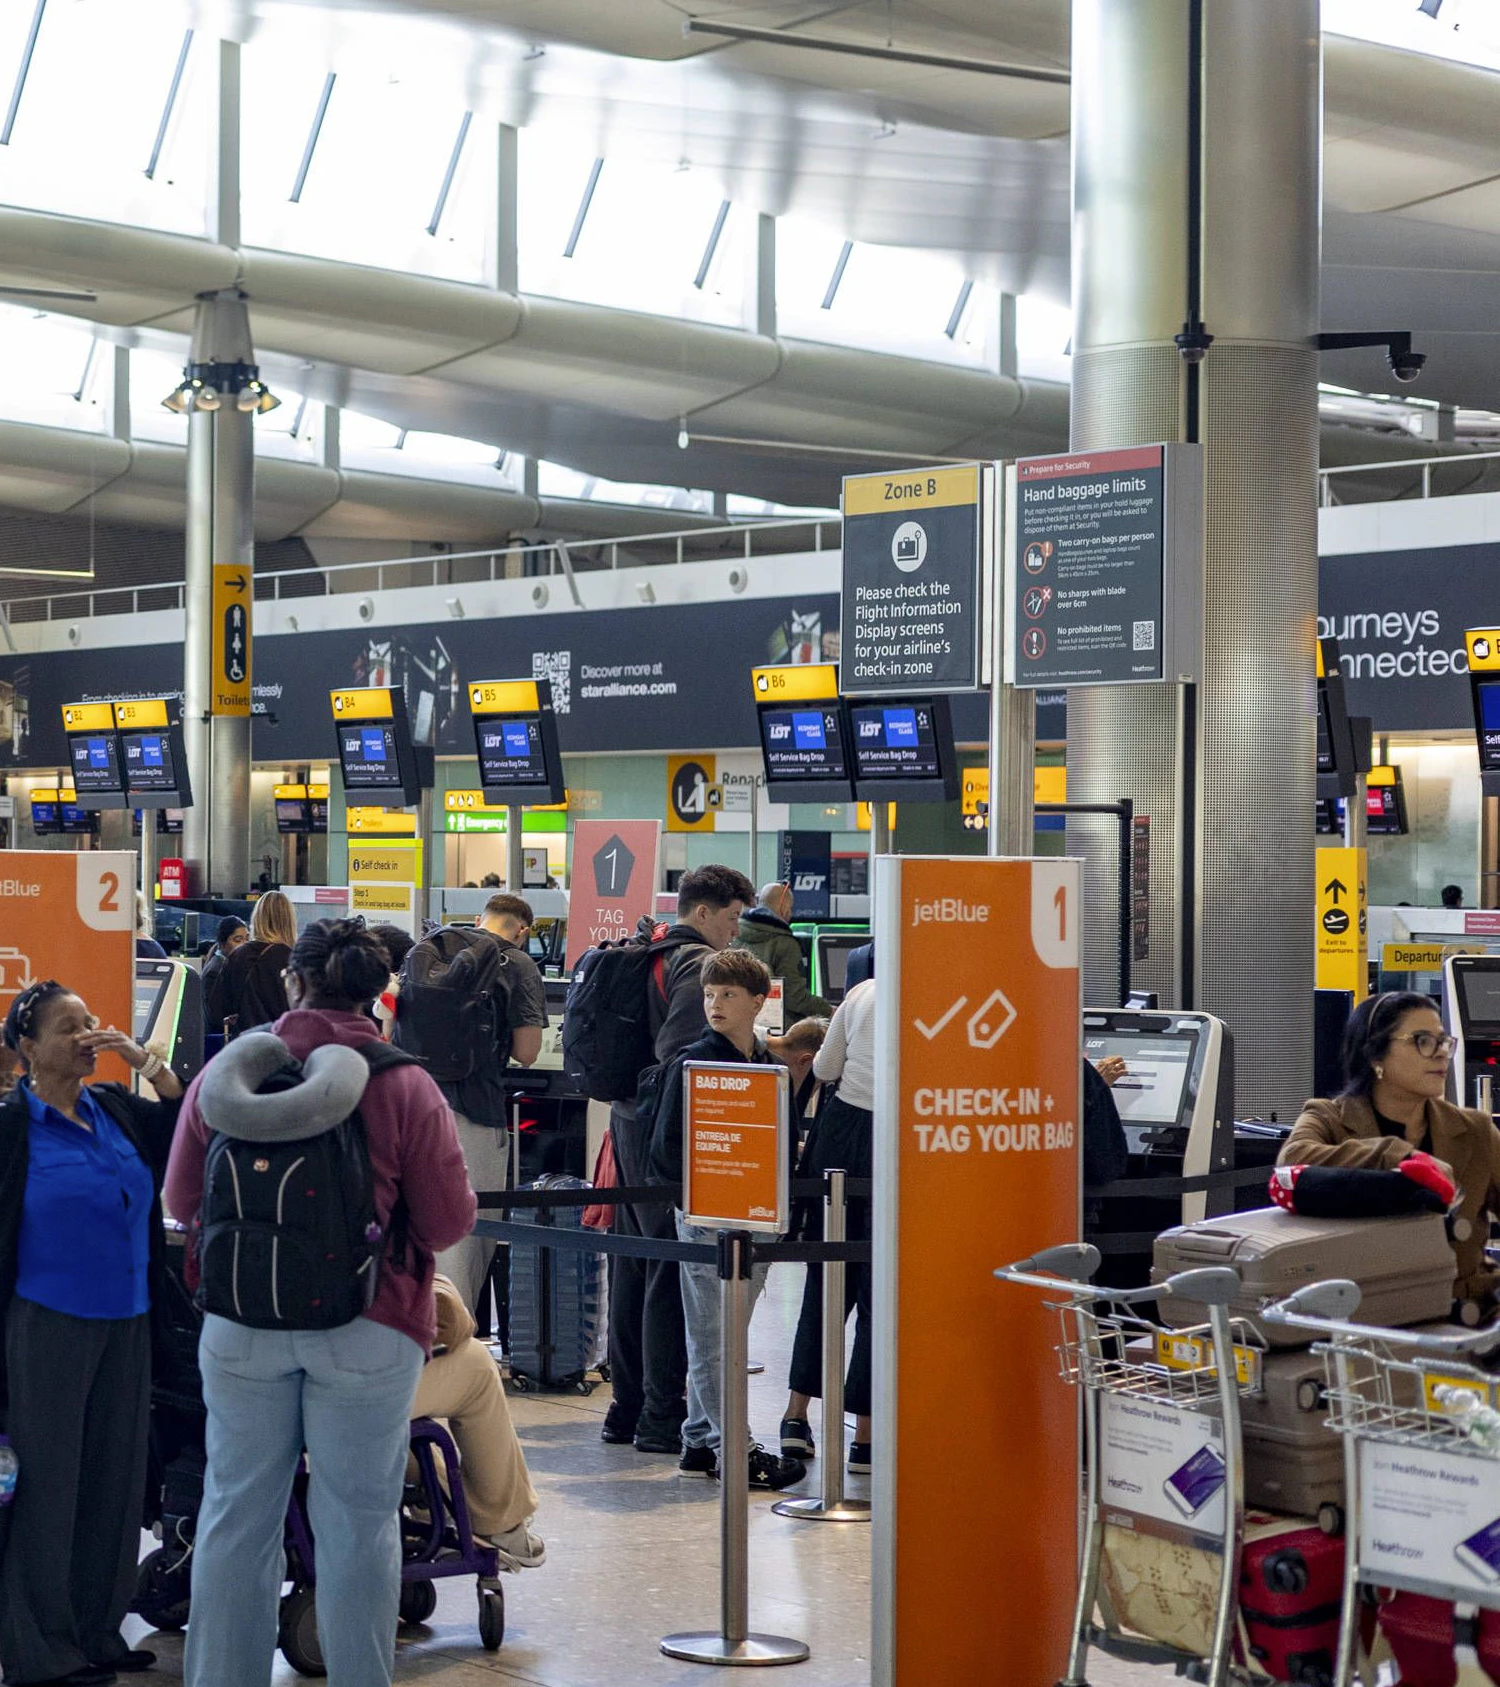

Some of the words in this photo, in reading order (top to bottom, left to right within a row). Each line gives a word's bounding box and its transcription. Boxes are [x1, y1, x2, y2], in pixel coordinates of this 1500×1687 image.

[1029, 464, 1054, 474] Prepare
[1054, 464, 1064, 472] for
[1065, 461, 1091, 471] Security
[884, 483, 922, 500] Zone
[927, 478, 937, 496] B
[1024, 486, 1055, 502] Hand
[1058, 483, 1110, 500] baggage
[1112, 477, 1146, 493] limits
[1058, 538, 1072, 547] Two
[1073, 537, 1100, 547] carry-on
[1101, 535, 1118, 544] bags
[1118, 534, 1131, 543] per
[1131, 532, 1155, 542] person
[856, 587, 892, 601] Please
[894, 582, 928, 598] check
[929, 581, 950, 595] the
[1058, 590, 1068, 599] No
[1068, 589, 1090, 599] sharps
[1091, 587, 1106, 596] with
[1107, 585, 1126, 595] blade
[856, 605, 888, 622] Flight
[891, 600, 961, 617] Information
[1073, 600, 1087, 608] 6cm
[856, 623, 897, 641] Display
[900, 622, 944, 636] screens
[1058, 626, 1067, 635] No
[1067, 625, 1102, 636] prohibited
[1103, 624, 1122, 632] items
[855, 644, 872, 658] for
[874, 645, 901, 660] your
[581, 665, 623, 679] Discover
[624, 664, 651, 676] more
[652, 662, 663, 675] at
[854, 661, 901, 677] check-in
[904, 662, 933, 674] zone
[772, 675, 785, 687] B6
[485, 689, 496, 701] B5
[581, 682, 677, 698] staralliance.com
[217, 695, 250, 706] Toilets
[770, 725, 791, 739] LOT
[860, 723, 882, 737] LOT
[346, 741, 361, 751] LOT
[485, 736, 501, 747] LOT
[769, 753, 780, 761] Self
[780, 753, 798, 761] Service
[799, 753, 810, 762] Bag
[811, 753, 825, 762] Drop
[859, 751, 869, 760] Self
[869, 751, 889, 760] Service
[890, 751, 901, 761] Bag
[902, 751, 917, 760] Drop
[163, 866, 180, 877] ATM
[361, 860, 372, 870] Self
[373, 860, 391, 870] check
[392, 860, 398, 870] in
[605, 848, 617, 890] 1
[793, 875, 826, 890] LOT
[99, 871, 119, 911] 2
[596, 909, 624, 924] TAG
[912, 899, 990, 926] jetBlue
[1054, 886, 1066, 942] 1
[589, 927, 629, 942] YOUR
[695, 1076, 718, 1089] BAG
[720, 1077, 751, 1092] DROP
[913, 1088, 1041, 1116] CHECK-IN
[1044, 1094, 1055, 1112] +
[696, 1131, 730, 1142] ENTREGA
[731, 1133, 742, 1143] DE
[913, 1125, 971, 1152] TAG
[978, 1124, 1042, 1151] YOUR
[1045, 1122, 1074, 1149] BAG
[696, 1142, 732, 1153] EQUIPAJE
[749, 1206, 775, 1217] jetBlue
[1391, 1462, 1436, 1479] Heathrow
[1439, 1470, 1480, 1486] Rewards
[1372, 1539, 1423, 1559] Heathrow
